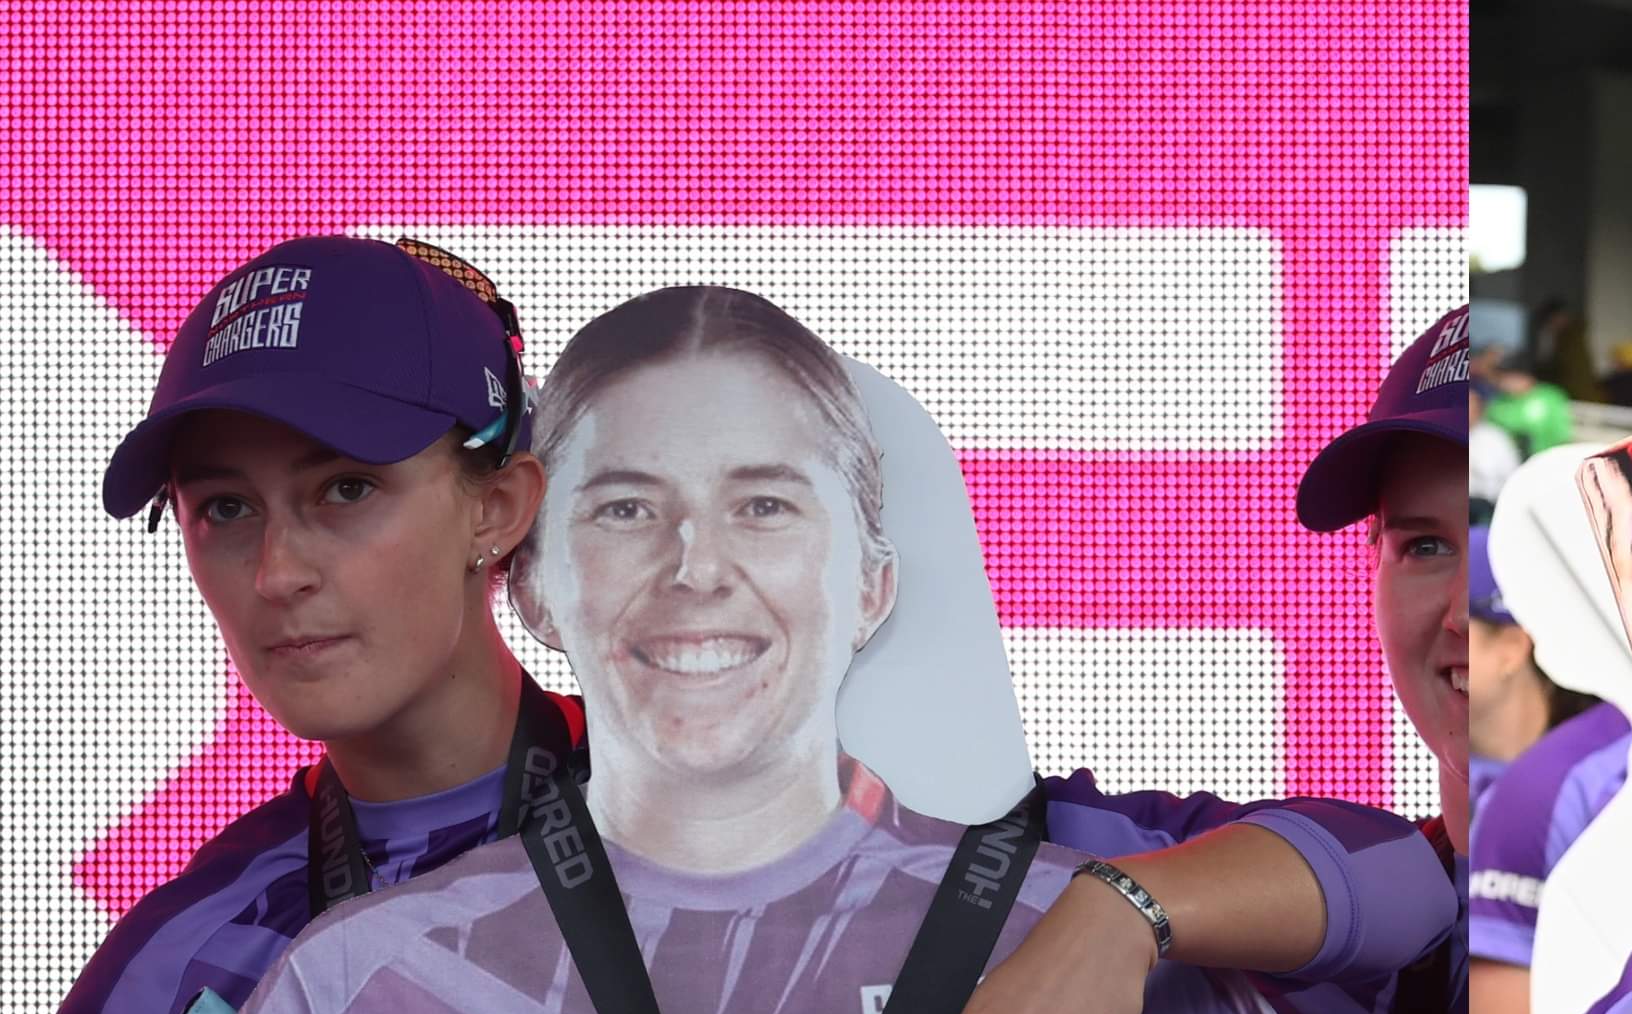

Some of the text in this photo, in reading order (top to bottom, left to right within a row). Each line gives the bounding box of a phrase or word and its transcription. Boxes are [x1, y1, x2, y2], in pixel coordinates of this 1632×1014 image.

[211, 267, 312, 328] SUPER
[203, 302, 303, 367] CHARGERS
[1416, 348, 1470, 394] CHARG
